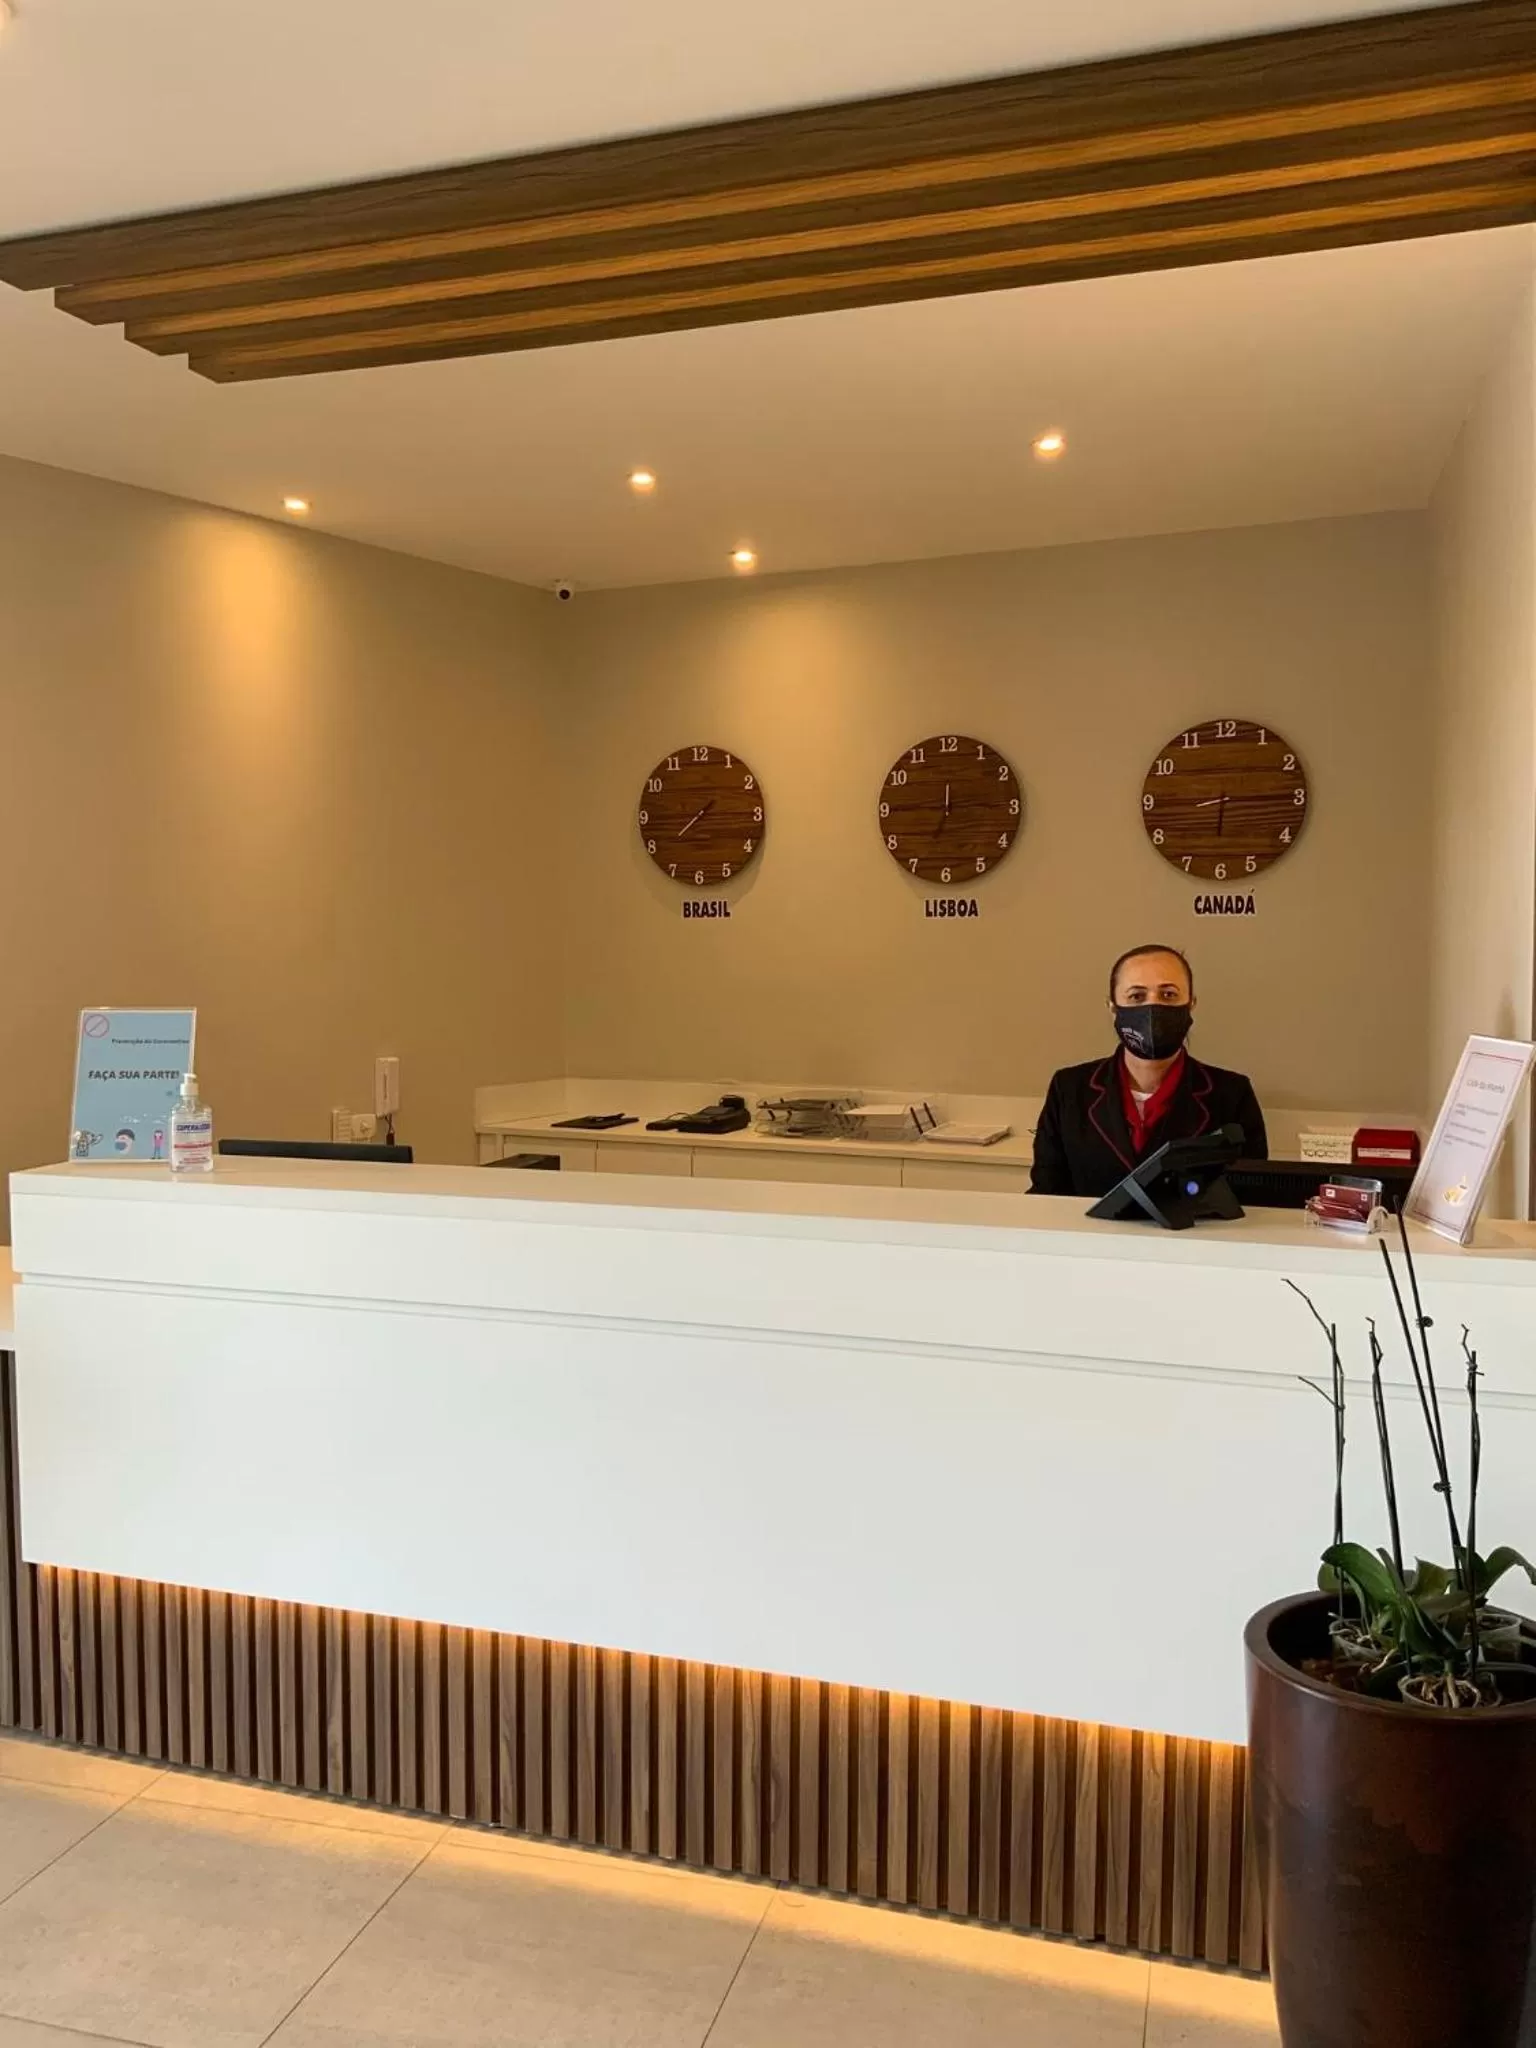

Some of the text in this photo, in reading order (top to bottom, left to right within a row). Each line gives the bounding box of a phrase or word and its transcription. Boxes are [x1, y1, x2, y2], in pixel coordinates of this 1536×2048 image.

[1216, 721, 1236, 737] 12
[1182, 733, 1200, 748] 11
[1258, 729, 1268, 745] 1
[939, 737, 958, 752] 12
[692, 747, 708, 761] 12
[911, 749, 926, 763] 11
[977, 746, 986, 760] 1
[668, 757, 680, 770] 11
[725, 755, 732, 768] 1
[1155, 759, 1173, 775] 10
[1283, 754, 1295, 770] 2
[891, 770, 907, 785] 10
[999, 766, 1008, 780] 2
[649, 778, 662, 792] 10
[745, 775, 753, 789] 2
[1143, 794, 1154, 810] 9
[1294, 789, 1304, 805] 3
[754, 807, 762, 821] 3
[880, 803, 890, 817] 9
[1009, 800, 1019, 814] 3
[640, 811, 648, 824] 9
[888, 835, 898, 849] 8
[998, 833, 1008, 847] 4
[1153, 829, 1164, 844] 8
[1279, 827, 1292, 843] 4
[648, 840, 656, 853] 8
[744, 839, 752, 852] 4
[669, 864, 677, 877] 7
[722, 864, 731, 877] 5
[909, 859, 918, 873] 7
[976, 857, 986, 872] 5
[1182, 856, 1192, 871] 7
[1246, 856, 1256, 872] 5
[695, 871, 703, 884] 6
[941, 868, 951, 882] 6
[1215, 864, 1226, 879] 6
[925, 900, 978, 917] LISBOA
[1194, 889, 1255, 914] CANADÁ
[683, 902, 730, 918] BRASIL
[88, 1070, 180, 1081] FAÇA SUA PARTE!
